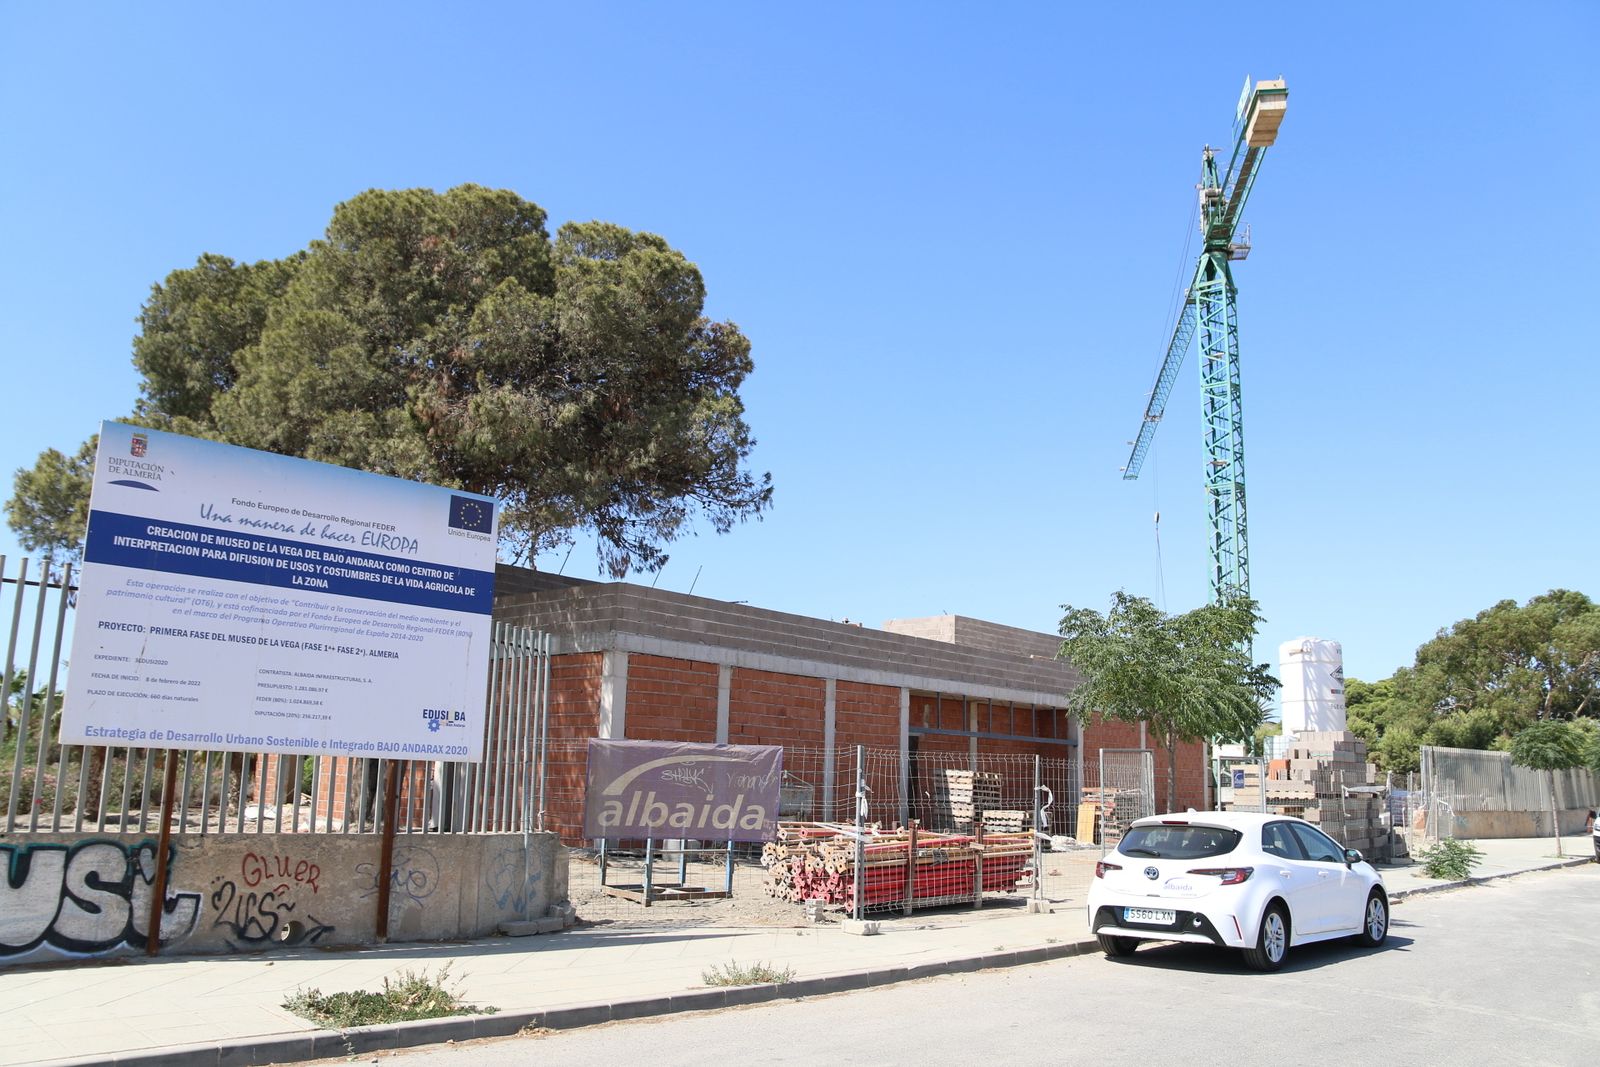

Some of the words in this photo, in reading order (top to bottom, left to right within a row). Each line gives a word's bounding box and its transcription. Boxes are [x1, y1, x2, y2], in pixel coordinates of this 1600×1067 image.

[108, 455, 164, 473] DIPUTACIÓN
[108, 465, 120, 473] DE
[123, 466, 162, 480] ALMERÍA
[200, 502, 233, 523] Una
[238, 515, 295, 533] manera
[299, 520, 316, 537] de
[320, 522, 356, 543] hacer
[361, 529, 418, 554] EUROPA
[232, 497, 256, 507] Fondo
[257, 502, 289, 514] Europeo
[291, 507, 300, 515] de
[302, 509, 339, 521] Desarrollo
[340, 516, 370, 528] Regional
[372, 522, 396, 531] FEDER
[448, 527, 465, 537] Unión
[466, 531, 490, 542] Europea
[113, 535, 200, 556] INTERPRETACION
[201, 548, 228, 560] PARA
[229, 552, 274, 567] DIFUSION
[276, 558, 288, 569] DE
[290, 560, 314, 572] USOS
[316, 564, 323, 573] Y
[323, 565, 380, 582] COSTUMBRES
[382, 574, 393, 584] DE
[394, 576, 404, 585] LA
[405, 578, 424, 588] VIDA
[425, 581, 463, 594] AGRICOLA
[465, 586, 475, 595] DE
[147, 525, 198, 541] CREACION
[200, 533, 214, 544] DE
[215, 535, 251, 549] MUSEO
[252, 541, 265, 551] DE
[267, 543, 278, 553] LA
[279, 545, 303, 557] VEGA
[304, 548, 321, 559] DEL
[323, 551, 345, 563] BAJO
[345, 555, 384, 569] ANDARAX
[386, 561, 410, 573] COMO
[412, 566, 442, 578] CENTRO
[444, 571, 454, 580] DE
[292, 575, 303, 585] LA
[304, 577, 329, 588] ZONA
[106, 587, 153, 601] patrimonio
[191, 597, 215, 608] (OT6),
[223, 601, 240, 610] está
[241, 603, 288, 616] cofinanciado
[311, 612, 332, 621] Fondo
[334, 615, 361, 625] Europeo
[372, 620, 405, 630] Desarrollo
[126, 578, 143, 588] Esta
[145, 581, 185, 593] operación
[187, 586, 195, 594] se
[197, 587, 223, 597] realiza
[225, 591, 239, 599] con
[240, 592, 247, 600] el
[249, 594, 279, 605] objetivo
[280, 597, 290, 605] de
[336, 604, 343, 612] la
[344, 606, 387, 618] conservación
[399, 613, 419, 621] medio
[420, 616, 449, 625] ambiente
[98, 620, 146, 633] PROYECTO:
[150, 626, 188, 637] PRIMERA
[189, 630, 210, 639] FASE
[211, 632, 227, 641] DEL
[228, 634, 257, 644] MUSEO
[258, 637, 268, 645] DE
[270, 638, 279, 646] LA
[280, 639, 300, 648] VEGA
[301, 641, 322, 652] (FASE
[337, 645, 354, 653] FASE
[369, 649, 399, 659] ALMERIA
[193, 610, 217, 618] marco
[219, 612, 232, 620] del
[233, 614, 270, 625] Programa
[271, 618, 307, 629] Operativo
[308, 622, 354, 635] Plurirregional
[366, 629, 389, 638] España
[390, 632, 423, 641] 2014-2020
[84, 725, 146, 741] Estrategia
[149, 728, 164, 740] de
[166, 729, 223, 743] Desarrollo
[226, 732, 264, 745] Urbano
[266, 734, 319, 747] Sostenible
[329, 739, 375, 752] Integrado
[377, 742, 400, 752] BAJO
[401, 743, 444, 754] ANDARAX
[445, 745, 468, 755] 2020
[598, 790, 766, 830] albaida
[1130, 909, 1153, 920] 5560
[1155, 911, 1174, 921] LXN
